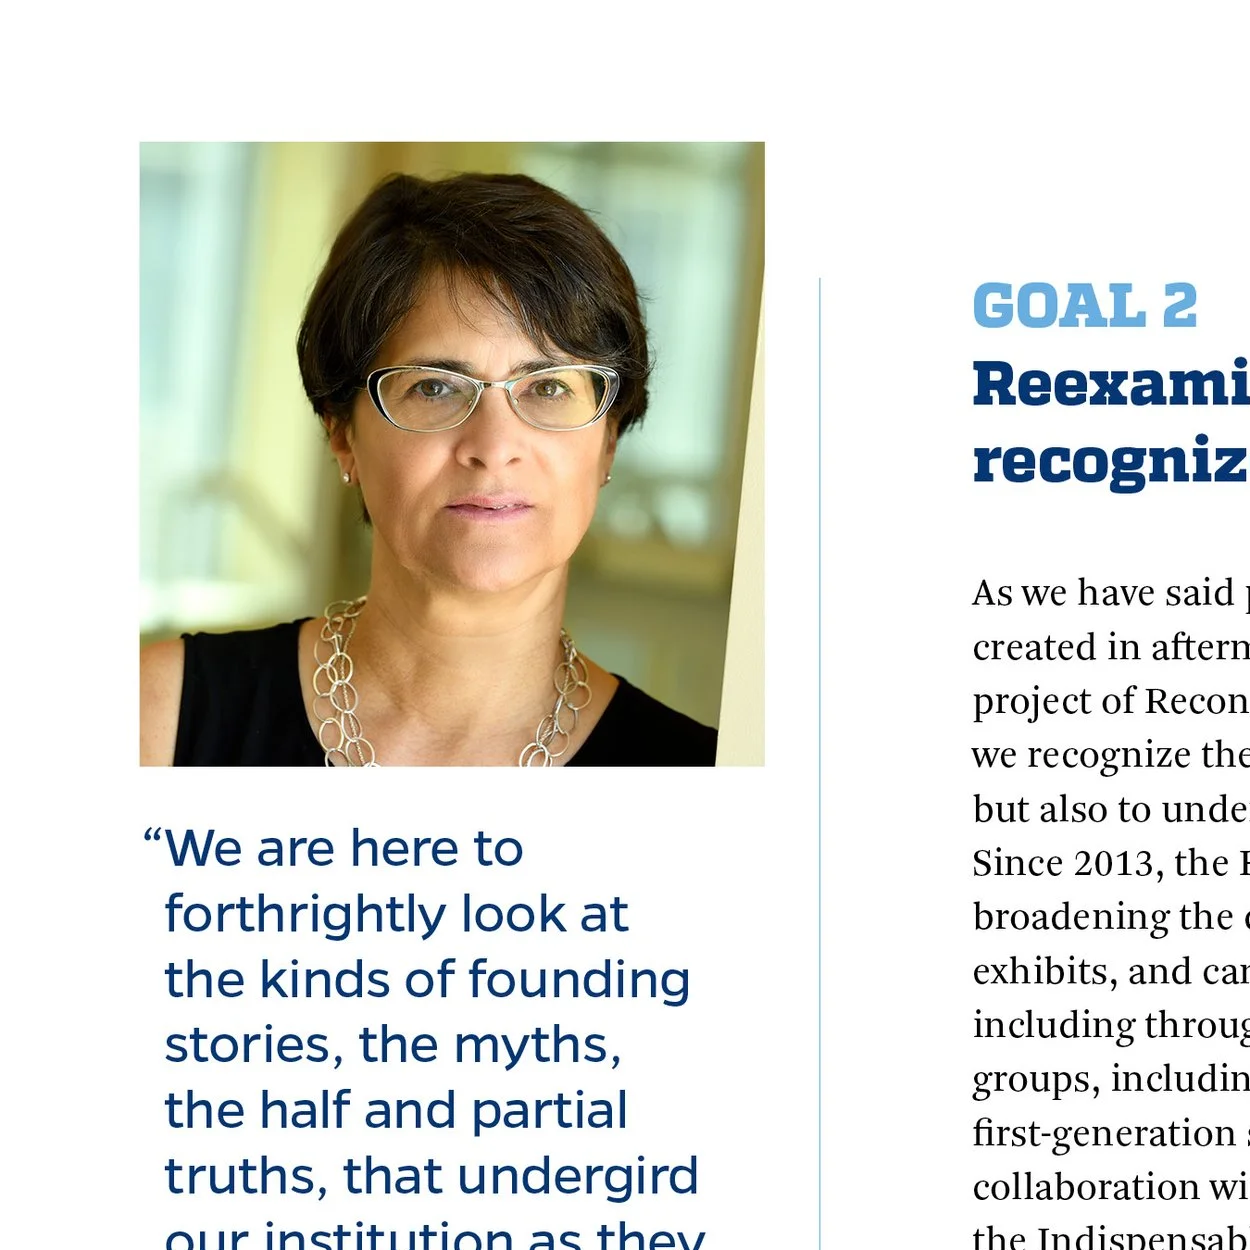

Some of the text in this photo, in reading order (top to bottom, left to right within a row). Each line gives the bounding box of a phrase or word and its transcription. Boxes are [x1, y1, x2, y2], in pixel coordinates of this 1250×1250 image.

[973, 281, 1197, 329] GOAL 2
[971, 578, 1013, 607] As
[1020, 585, 1067, 607] we
[1077, 576, 1155, 607] have
[1165, 576, 1235, 607] said
[143, 826, 523, 867] “We are here to
[973, 846, 1063, 877] Since
[1074, 850, 1164, 884] 2013,
[1174, 847, 1229, 877] the
[164, 957, 689, 1008] the kinds of founding
[971, 1071, 1100, 1102] groups,
[164, 1088, 626, 1138] the half and partial
[973, 1170, 1201, 1201] collaboration
